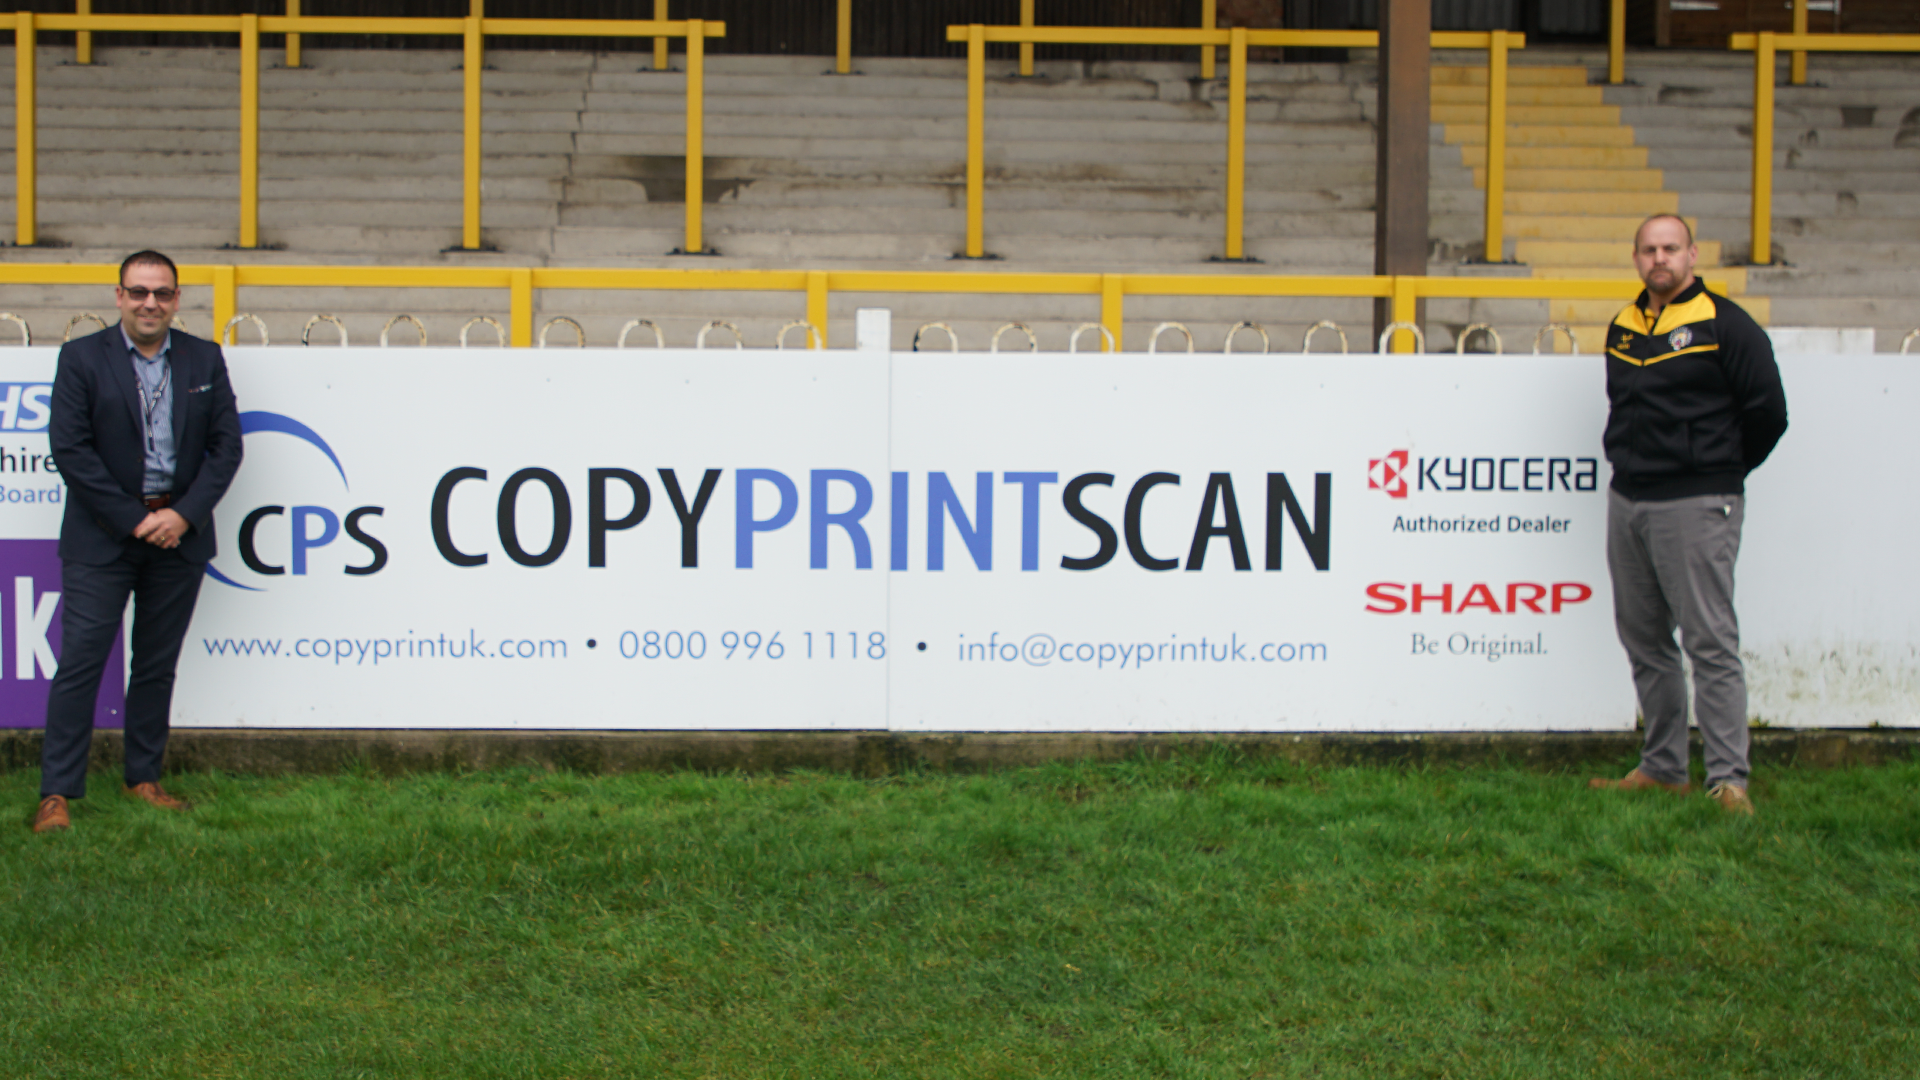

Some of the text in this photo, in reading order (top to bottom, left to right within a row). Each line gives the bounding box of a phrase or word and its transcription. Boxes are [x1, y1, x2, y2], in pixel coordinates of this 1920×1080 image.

[429, 465, 1333, 573] COPYPRINTSCAN
[1393, 514, 1572, 533] Authorized Dealer
[238, 504, 389, 576] CPS
[1365, 582, 1593, 614] SHARP
[203, 629, 1327, 669] www.copyprintuk.com 0800 996 1118 info@copyprintuk.com
[1410, 632, 1548, 662] Be Original.
